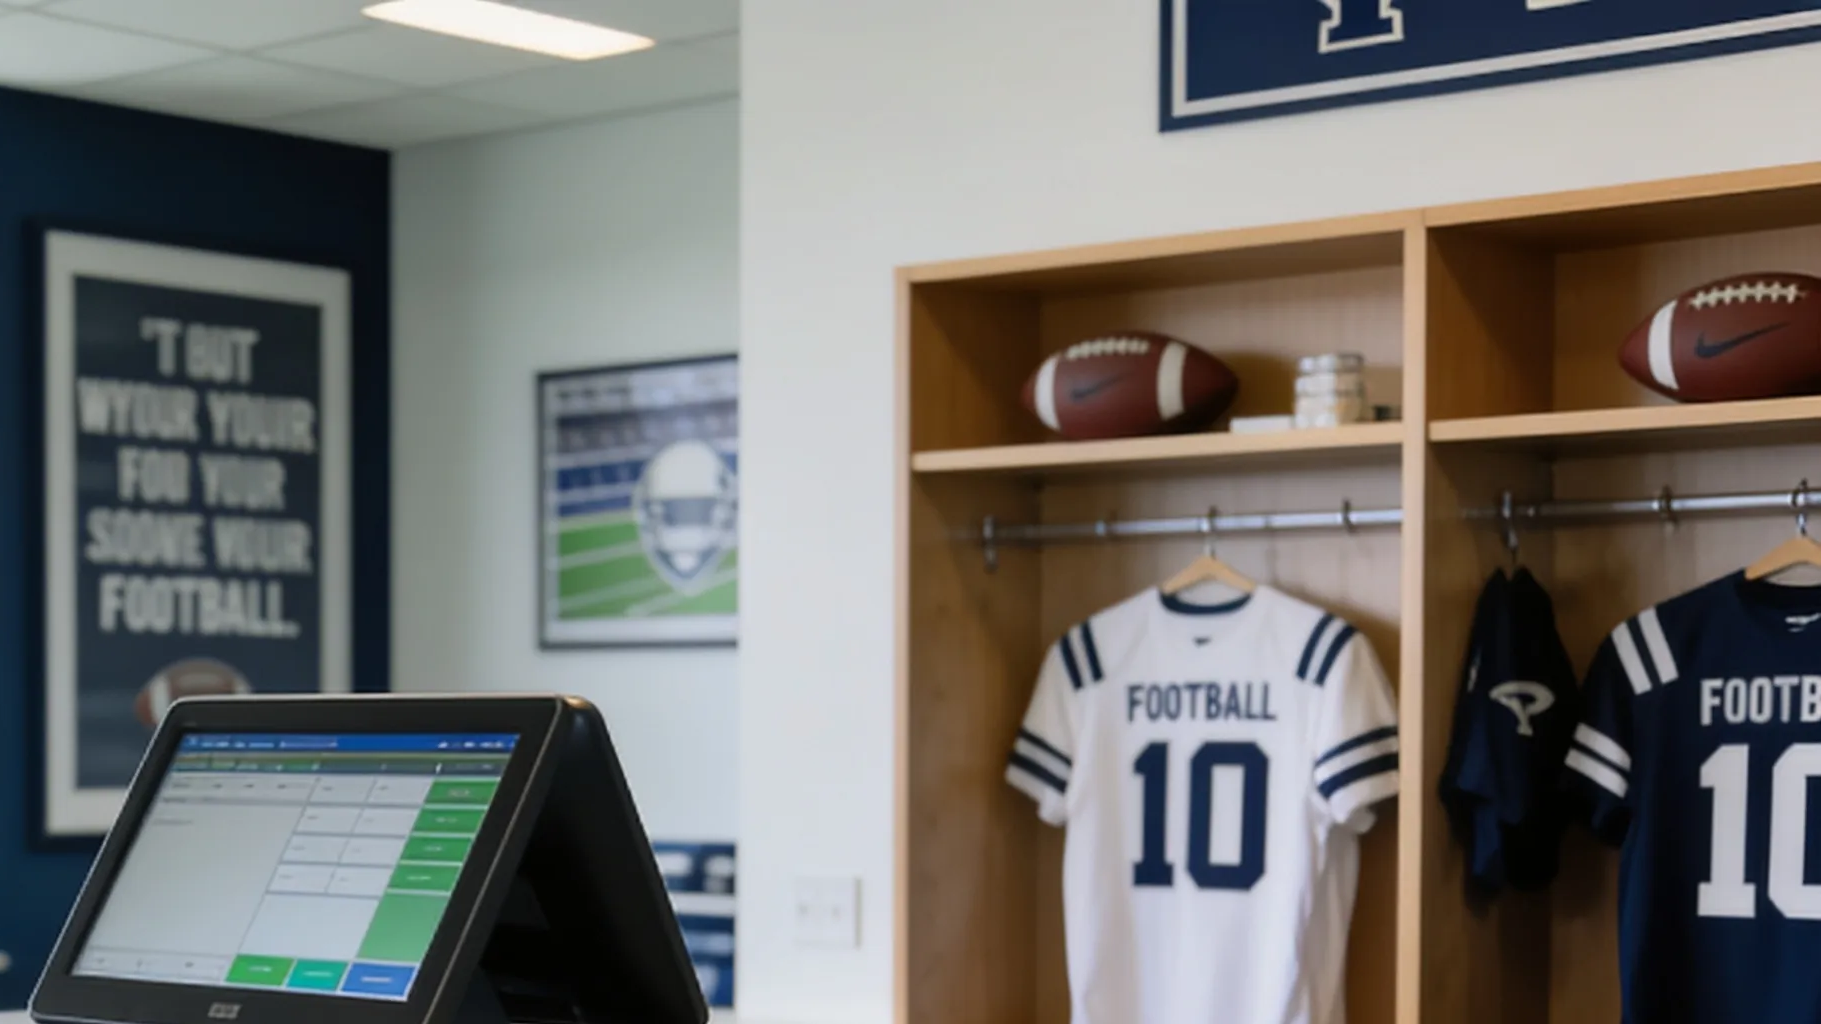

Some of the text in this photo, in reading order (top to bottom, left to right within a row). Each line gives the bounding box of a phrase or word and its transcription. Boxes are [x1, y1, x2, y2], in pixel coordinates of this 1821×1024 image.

[185, 323, 260, 384] BUT
[1127, 681, 1277, 722] FOOTBALL
[1133, 741, 1270, 892] 10
